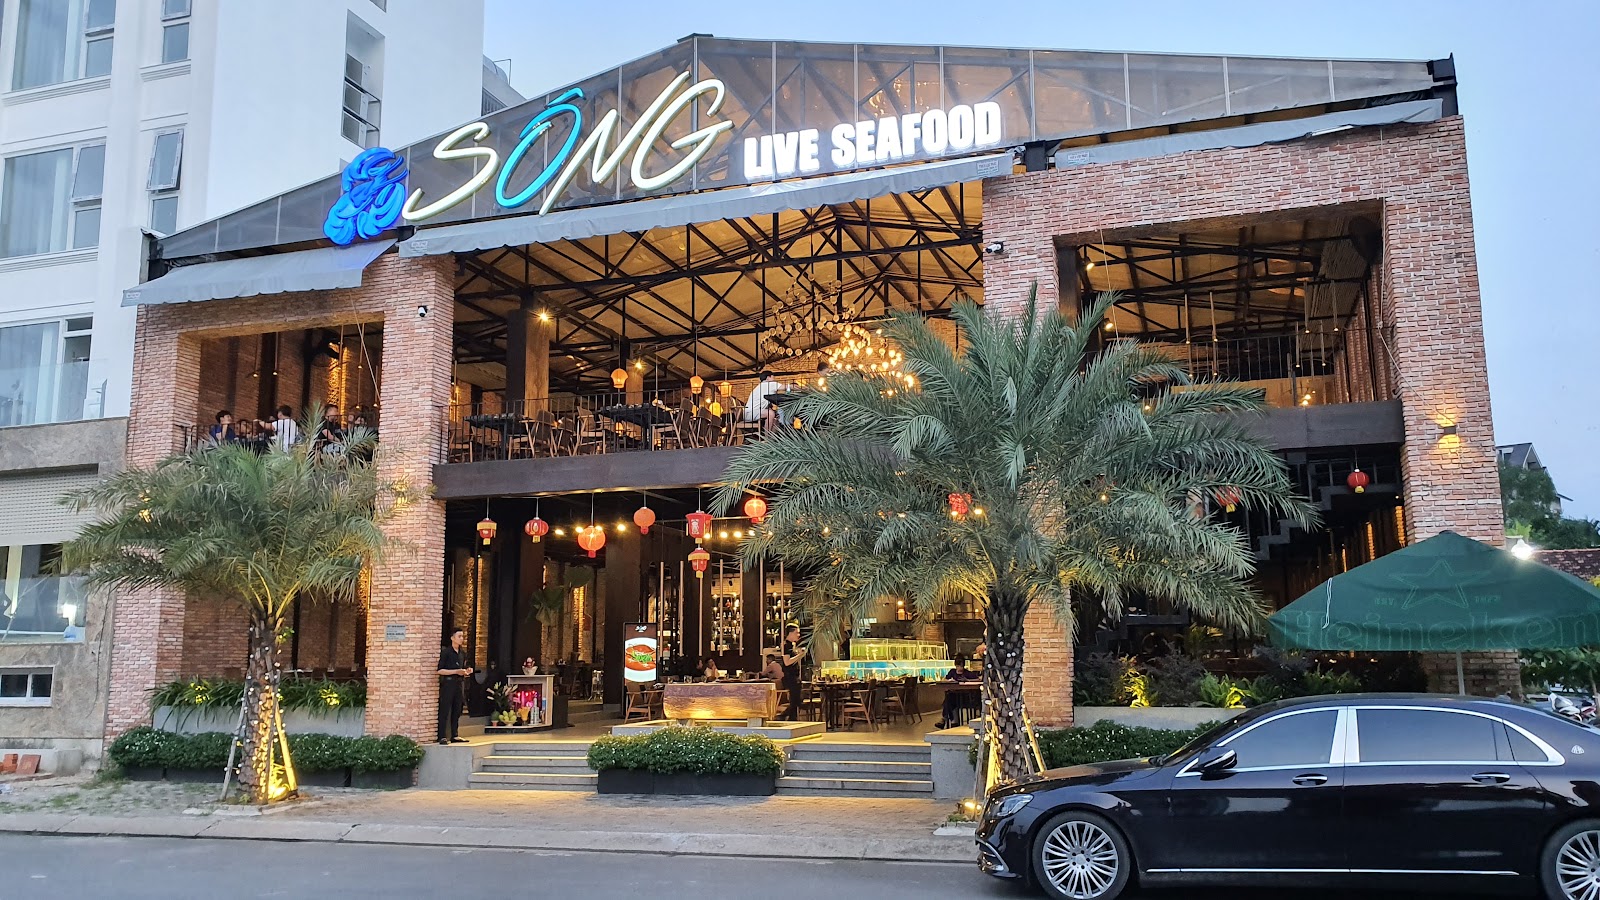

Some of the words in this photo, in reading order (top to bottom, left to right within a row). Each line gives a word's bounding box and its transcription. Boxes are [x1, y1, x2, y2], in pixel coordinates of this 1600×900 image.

[743, 128, 820, 181] LIVE
[831, 102, 1002, 168] SEAFOOD
[1281, 610, 1600, 650] Heineken
